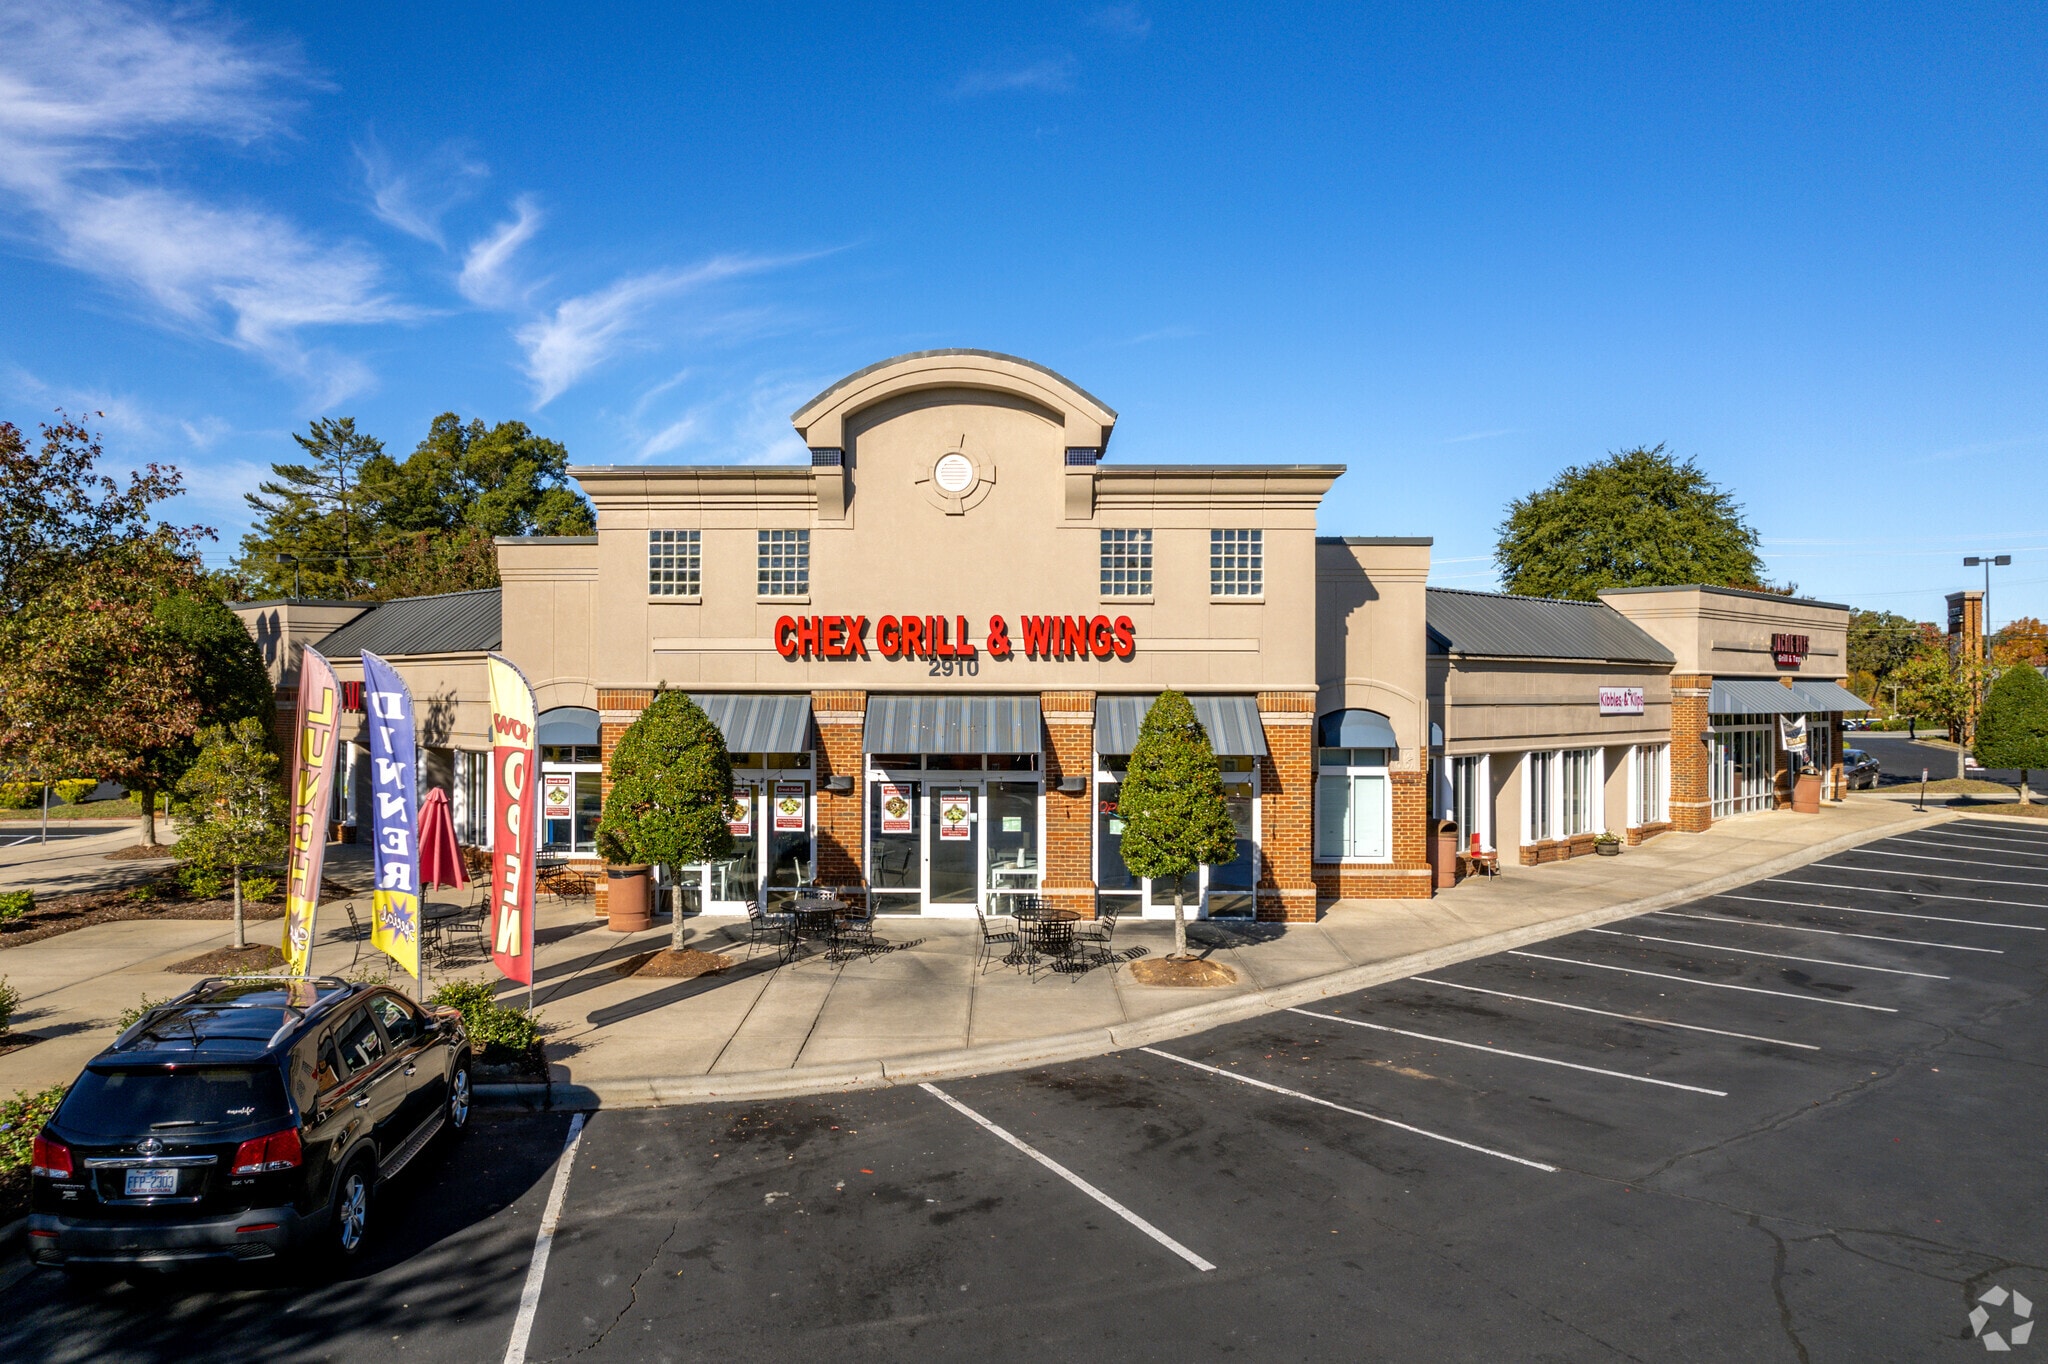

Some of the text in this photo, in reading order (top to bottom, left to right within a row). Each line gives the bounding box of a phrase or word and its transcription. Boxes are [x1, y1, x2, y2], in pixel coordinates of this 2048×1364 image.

[774, 614, 1135, 657] CHEX GRILL & WINGS
[928, 659, 979, 677] 2910
[1600, 691, 1643, 710] Kibbles & Klips
[1099, 800, 1118, 816] OP
[128, 1175, 174, 1188] FFP-2303
